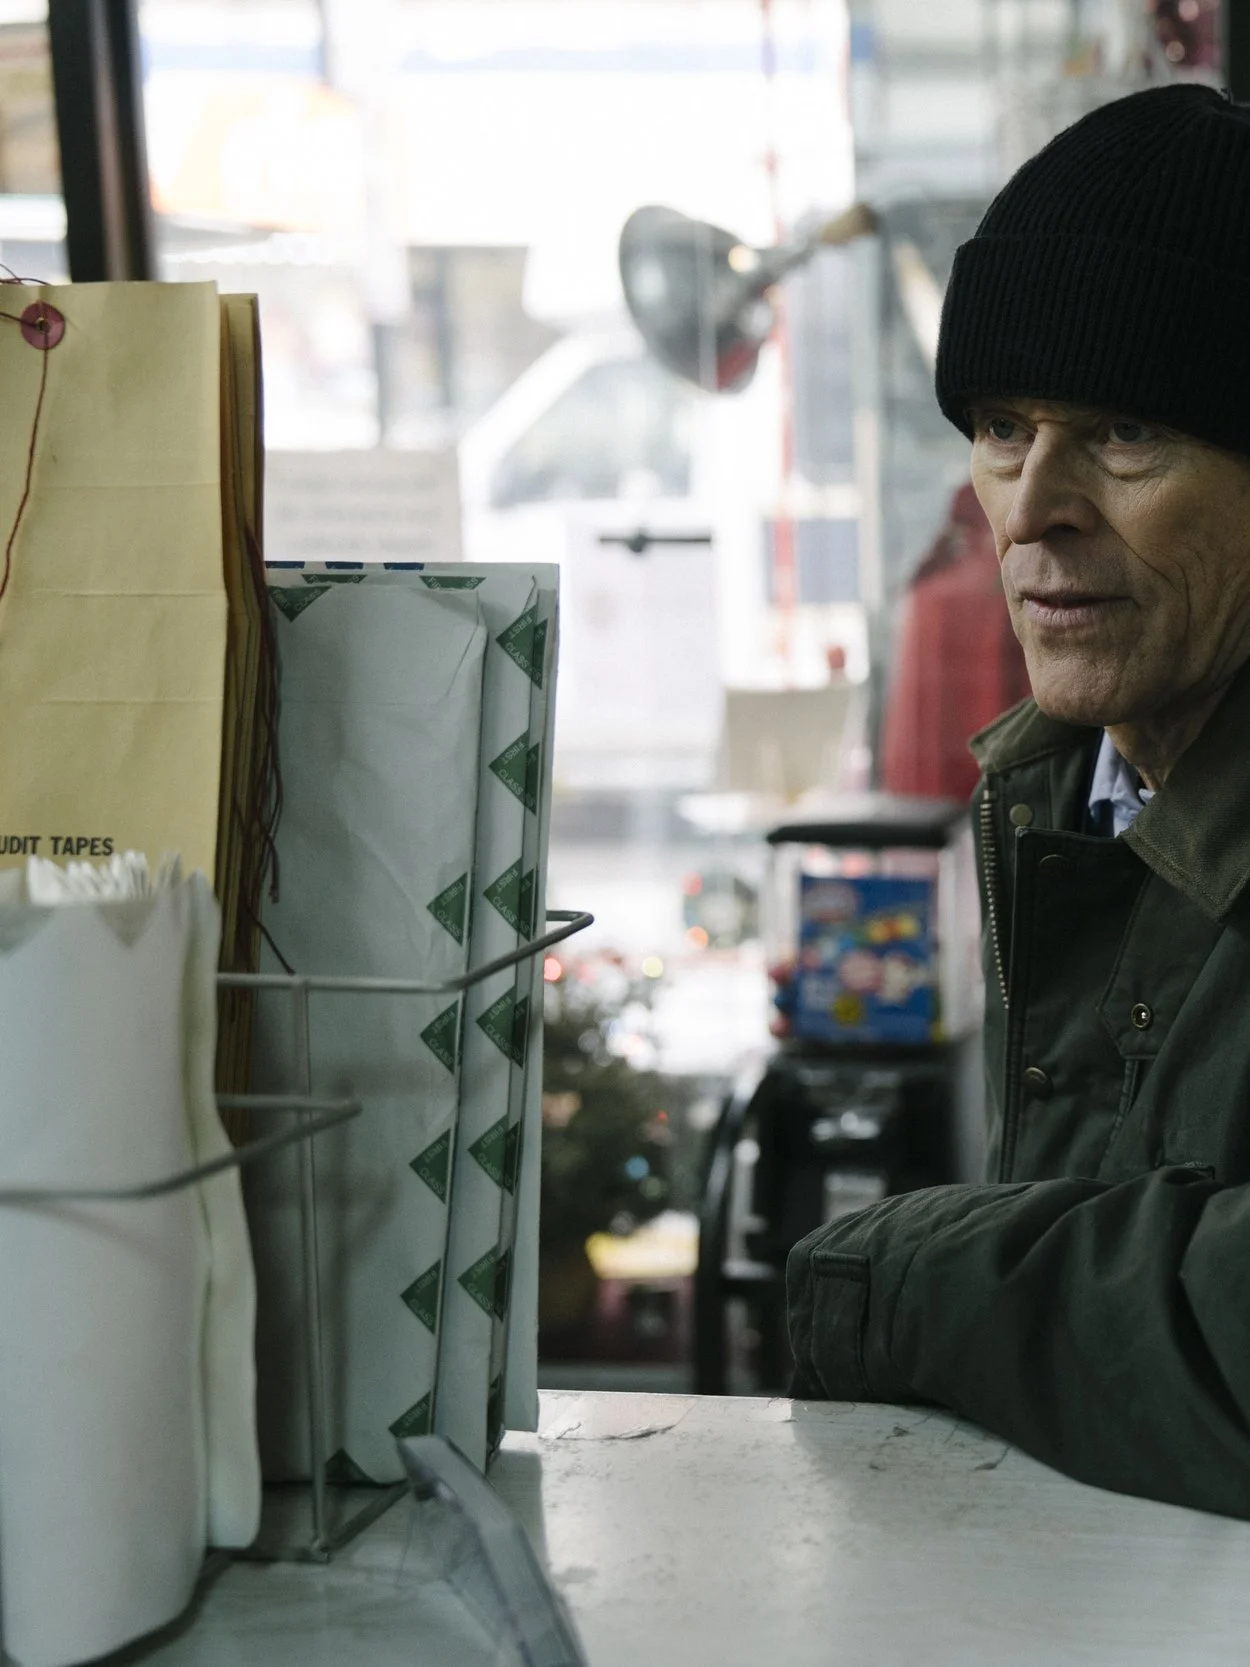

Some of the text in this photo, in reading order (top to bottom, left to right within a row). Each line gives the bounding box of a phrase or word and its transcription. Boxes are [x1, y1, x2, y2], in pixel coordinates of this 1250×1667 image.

[293, 587, 322, 612] CLASS
[508, 615, 533, 639] FIRST
[505, 642, 530, 669] CLASS
[501, 741, 525, 765] FIRST
[498, 768, 524, 795] CLASS
[50, 836, 114, 856] TAPES
[436, 910, 463, 937] CLASS
[492, 896, 518, 924] CLASS
[484, 1023, 510, 1051] CLASS
